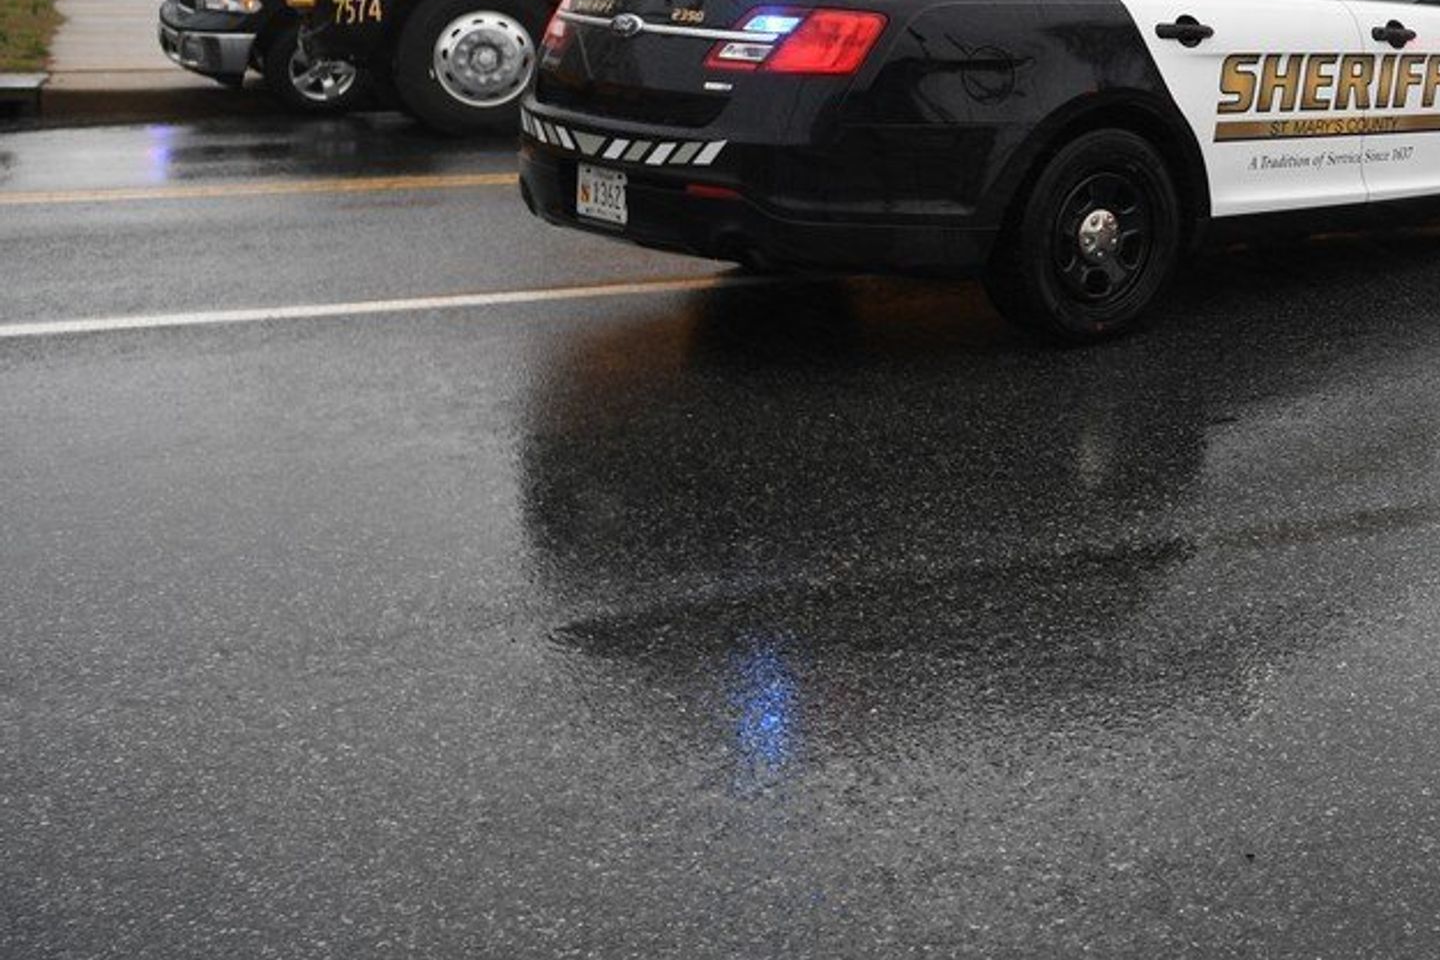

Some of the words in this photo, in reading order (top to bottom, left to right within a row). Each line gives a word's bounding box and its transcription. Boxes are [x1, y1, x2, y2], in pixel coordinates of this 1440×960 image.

[1294, 118, 1344, 134] MARY'S
[1346, 116, 1400, 132] COUNTY
[1248, 156, 1258, 170] A
[1261, 153, 1310, 170] Tradition
[1312, 151, 1326, 169] of
[1364, 148, 1390, 163] Since
